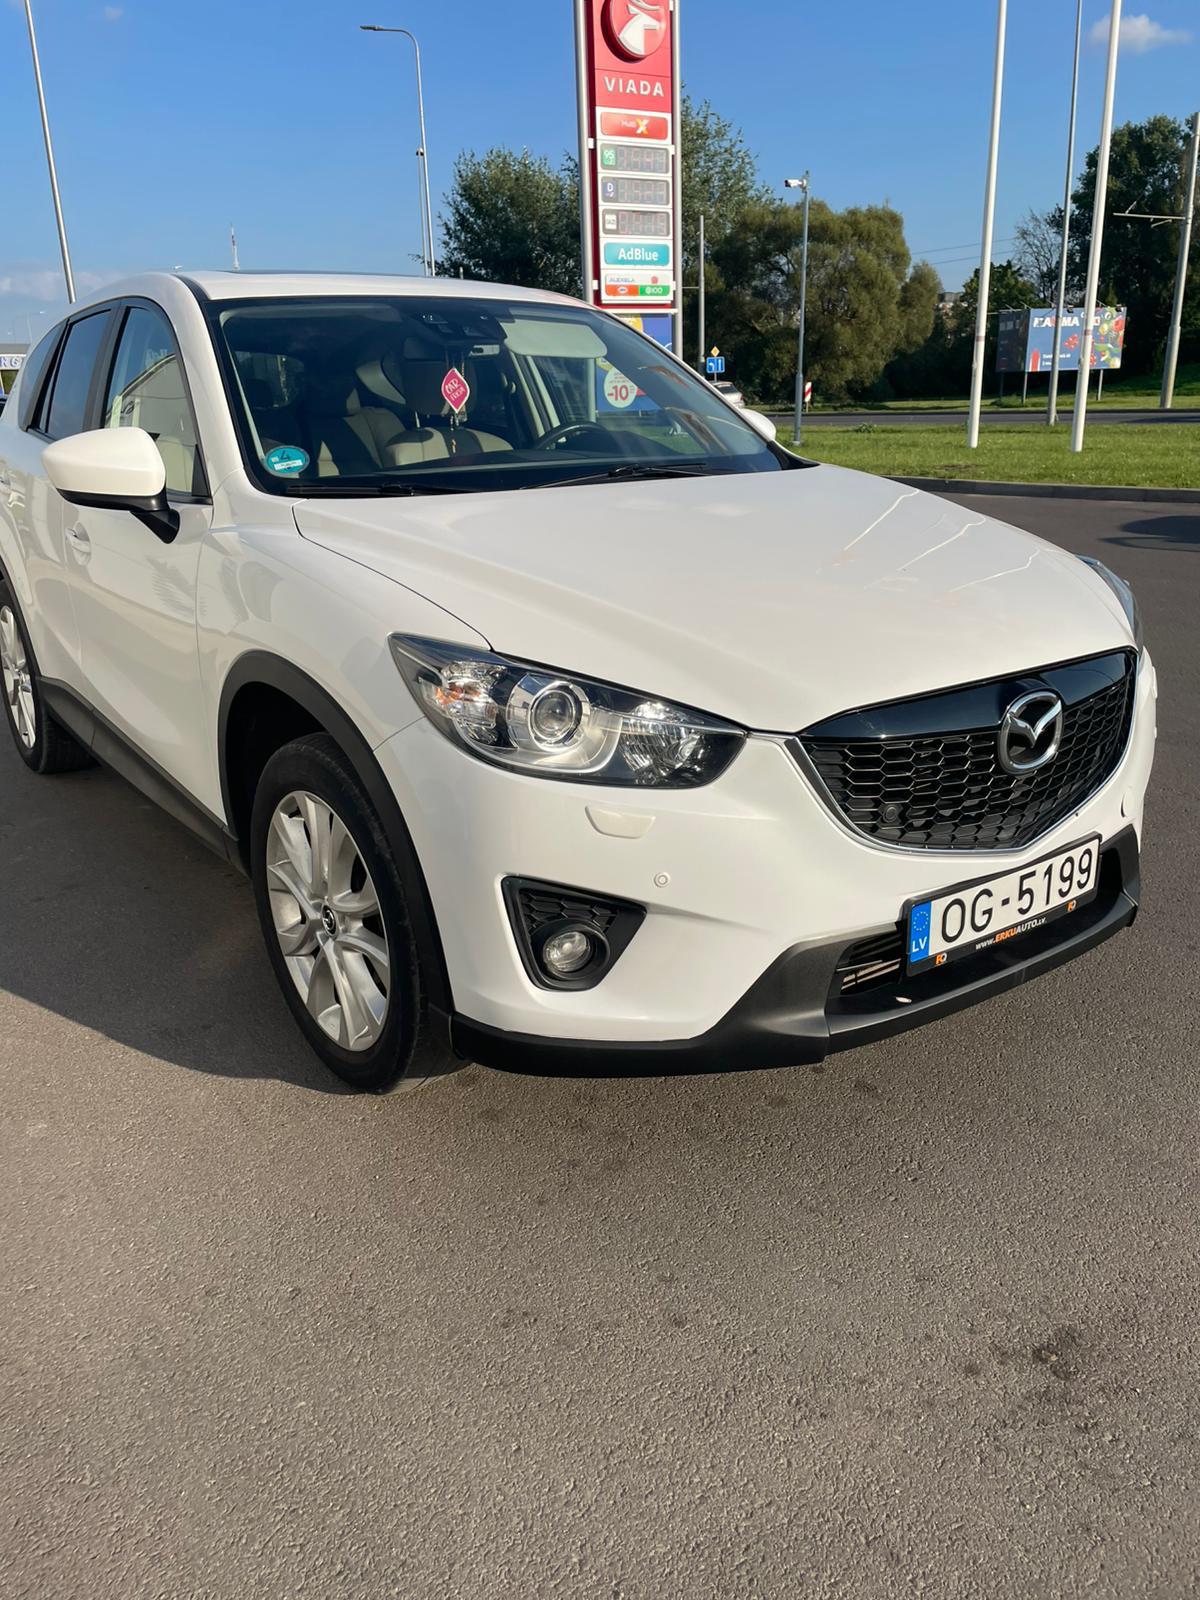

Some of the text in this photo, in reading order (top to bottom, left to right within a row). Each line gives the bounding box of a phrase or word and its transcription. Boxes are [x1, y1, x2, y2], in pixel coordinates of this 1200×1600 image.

[604, 76, 664, 97] VIADA
[618, 247, 659, 261] AdBlue
[941, 848, 1092, 944] OG-5199
[912, 936, 928, 953] LV
